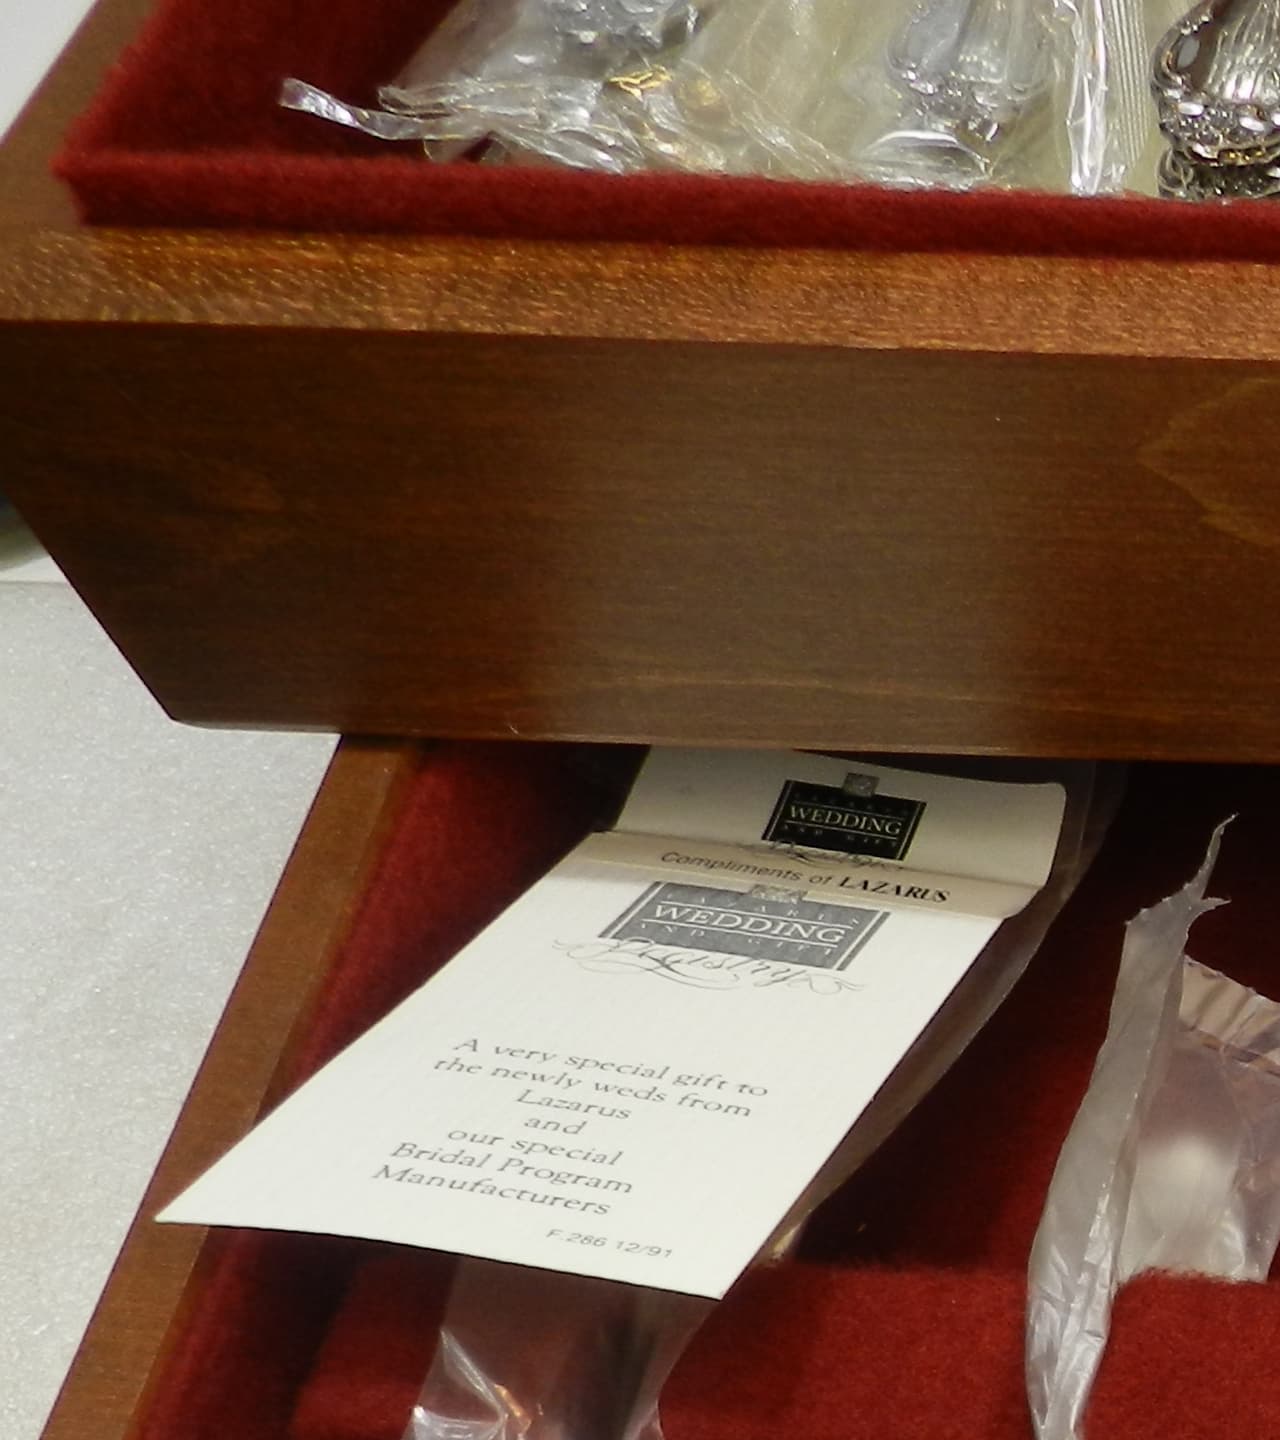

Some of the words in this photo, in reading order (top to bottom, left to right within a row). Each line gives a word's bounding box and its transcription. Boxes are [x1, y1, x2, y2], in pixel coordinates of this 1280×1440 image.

[789, 804, 903, 835] WEDDING
[660, 850, 801, 882] Compliments
[808, 871, 833, 886] of
[838, 875, 952, 904] LAZARUS
[653, 903, 846, 944] WEDDING
[433, 1057, 483, 1075] the
[489, 1066, 583, 1090] newly
[593, 1080, 668, 1102] weds
[676, 1092, 752, 1118] from
[452, 1038, 480, 1053] A
[493, 1043, 558, 1064] very
[564, 1054, 671, 1080] special
[672, 1069, 730, 1092] gift
[737, 1082, 769, 1097] to
[515, 1088, 632, 1121] Lazarus
[523, 1116, 588, 1136] and
[390, 1141, 494, 1169] Bridal
[496, 1156, 634, 1194] Program
[447, 1129, 505, 1147] our
[510, 1138, 625, 1167] special
[370, 1163, 612, 1217] Manufacturers
